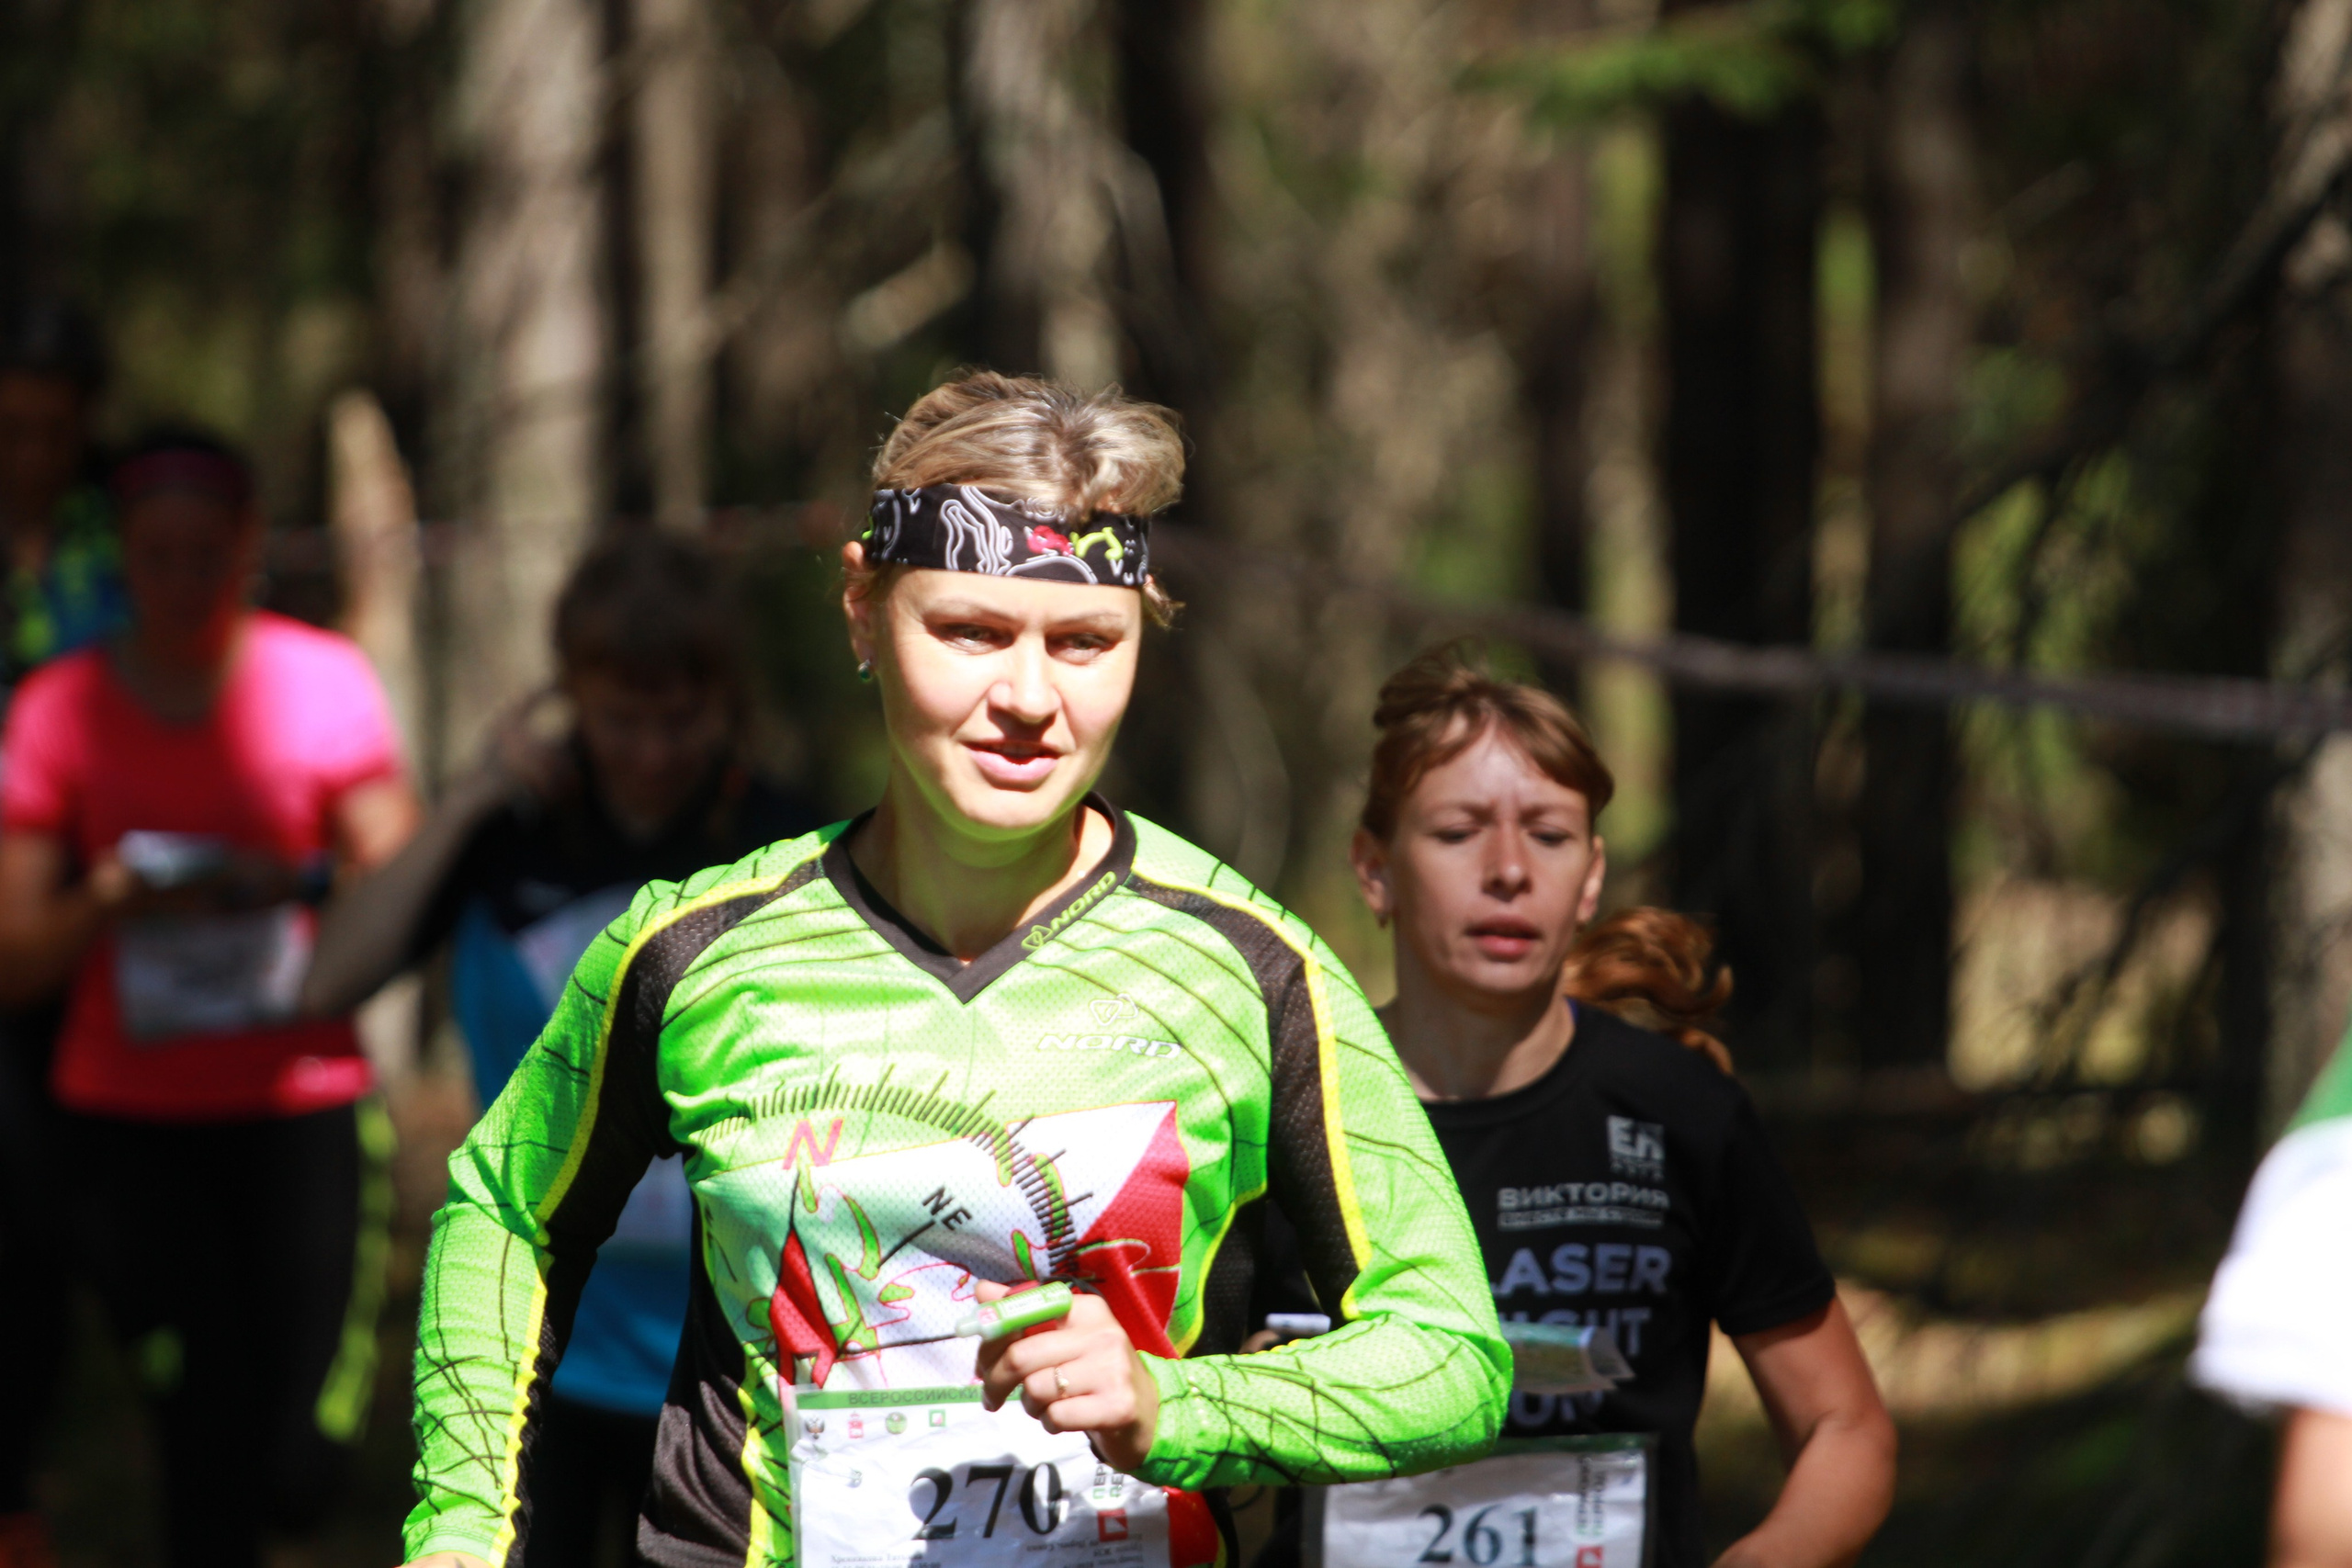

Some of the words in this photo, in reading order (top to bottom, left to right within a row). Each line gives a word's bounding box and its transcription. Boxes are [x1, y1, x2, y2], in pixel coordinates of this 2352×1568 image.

[1050, 871, 1118, 937] NORD
[1037, 1034, 1182, 1058] NORD
[782, 1117, 844, 1170] N
[922, 1186, 973, 1232] NE
[1497, 1181, 1671, 1212] ВИКТОРИЯ
[1491, 1243, 1671, 1295] ASER
[848, 1385, 982, 1405] ВСЕРОССИЙСКИ
[909, 1461, 1063, 1541] 270
[1418, 1502, 1540, 1568] 261
